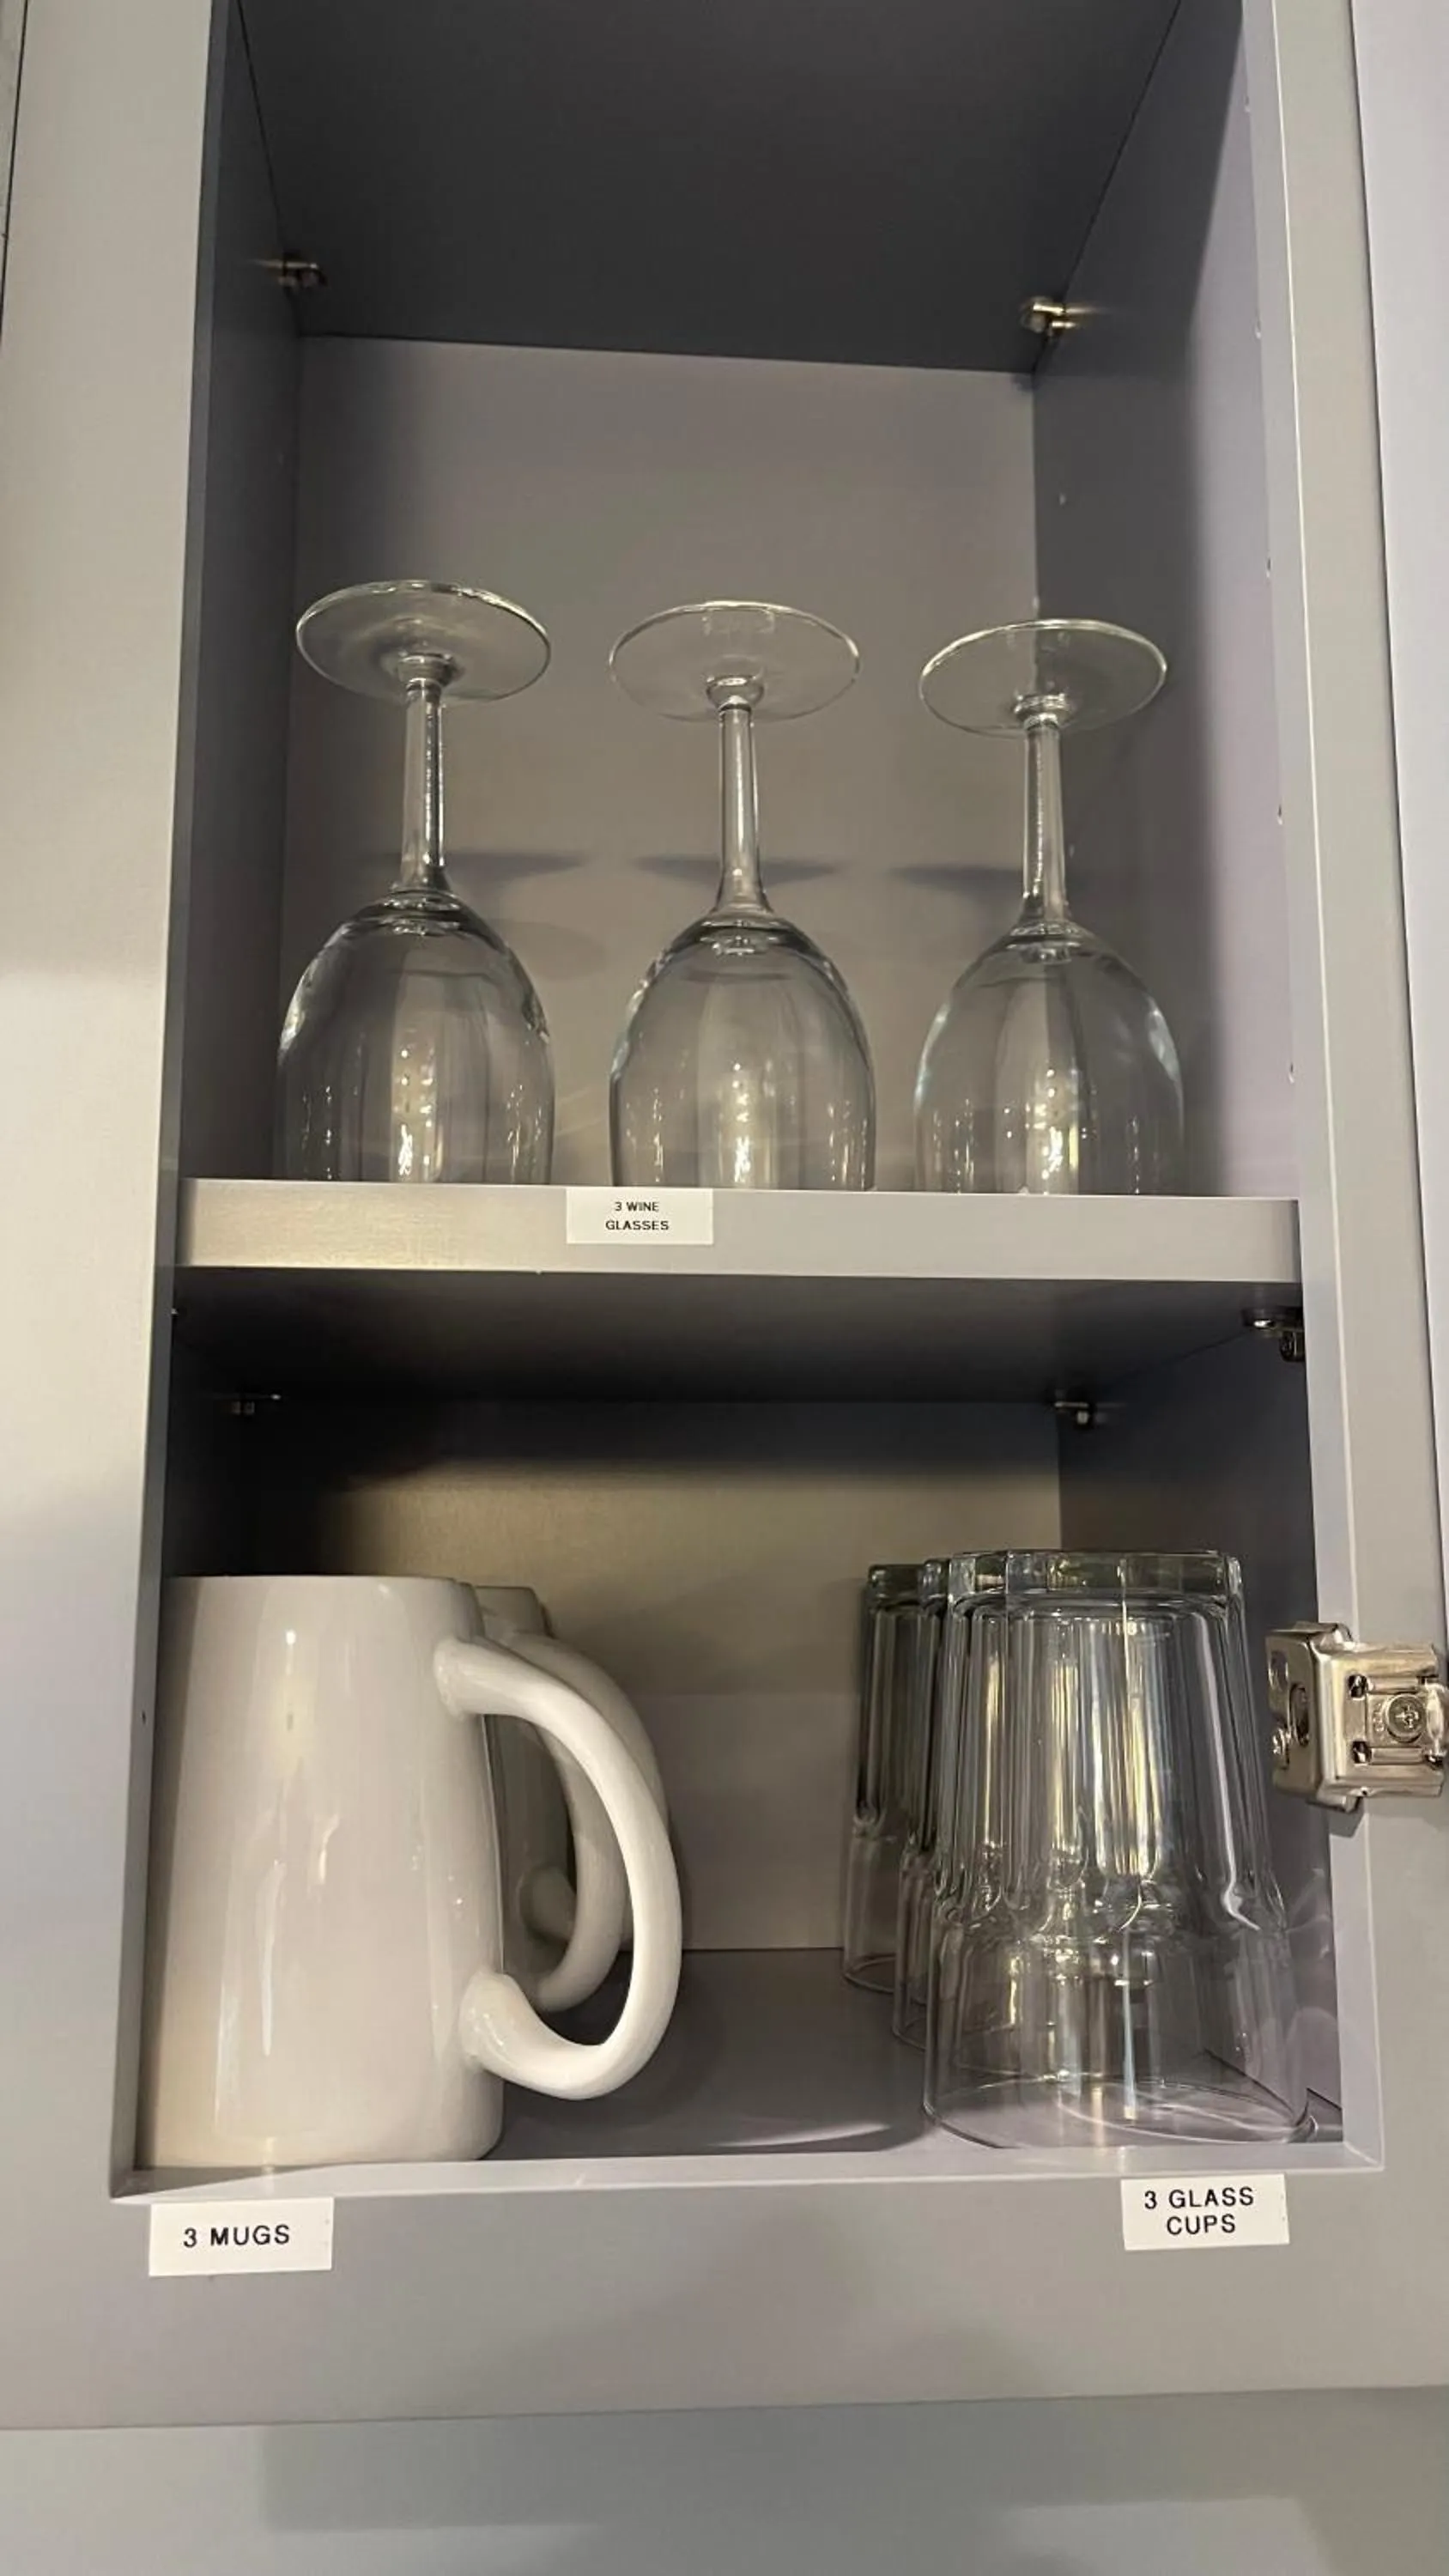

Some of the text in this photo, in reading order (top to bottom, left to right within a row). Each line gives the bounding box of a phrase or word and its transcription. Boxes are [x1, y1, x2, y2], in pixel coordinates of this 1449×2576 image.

[615, 1201, 659, 1212] 3 WINE
[605, 1220, 670, 1230] GLASSES
[1144, 2186, 1254, 2209] 3 GLASS
[183, 2224, 290, 2248] 3 MUGS
[1166, 2213, 1236, 2236] CUPS
